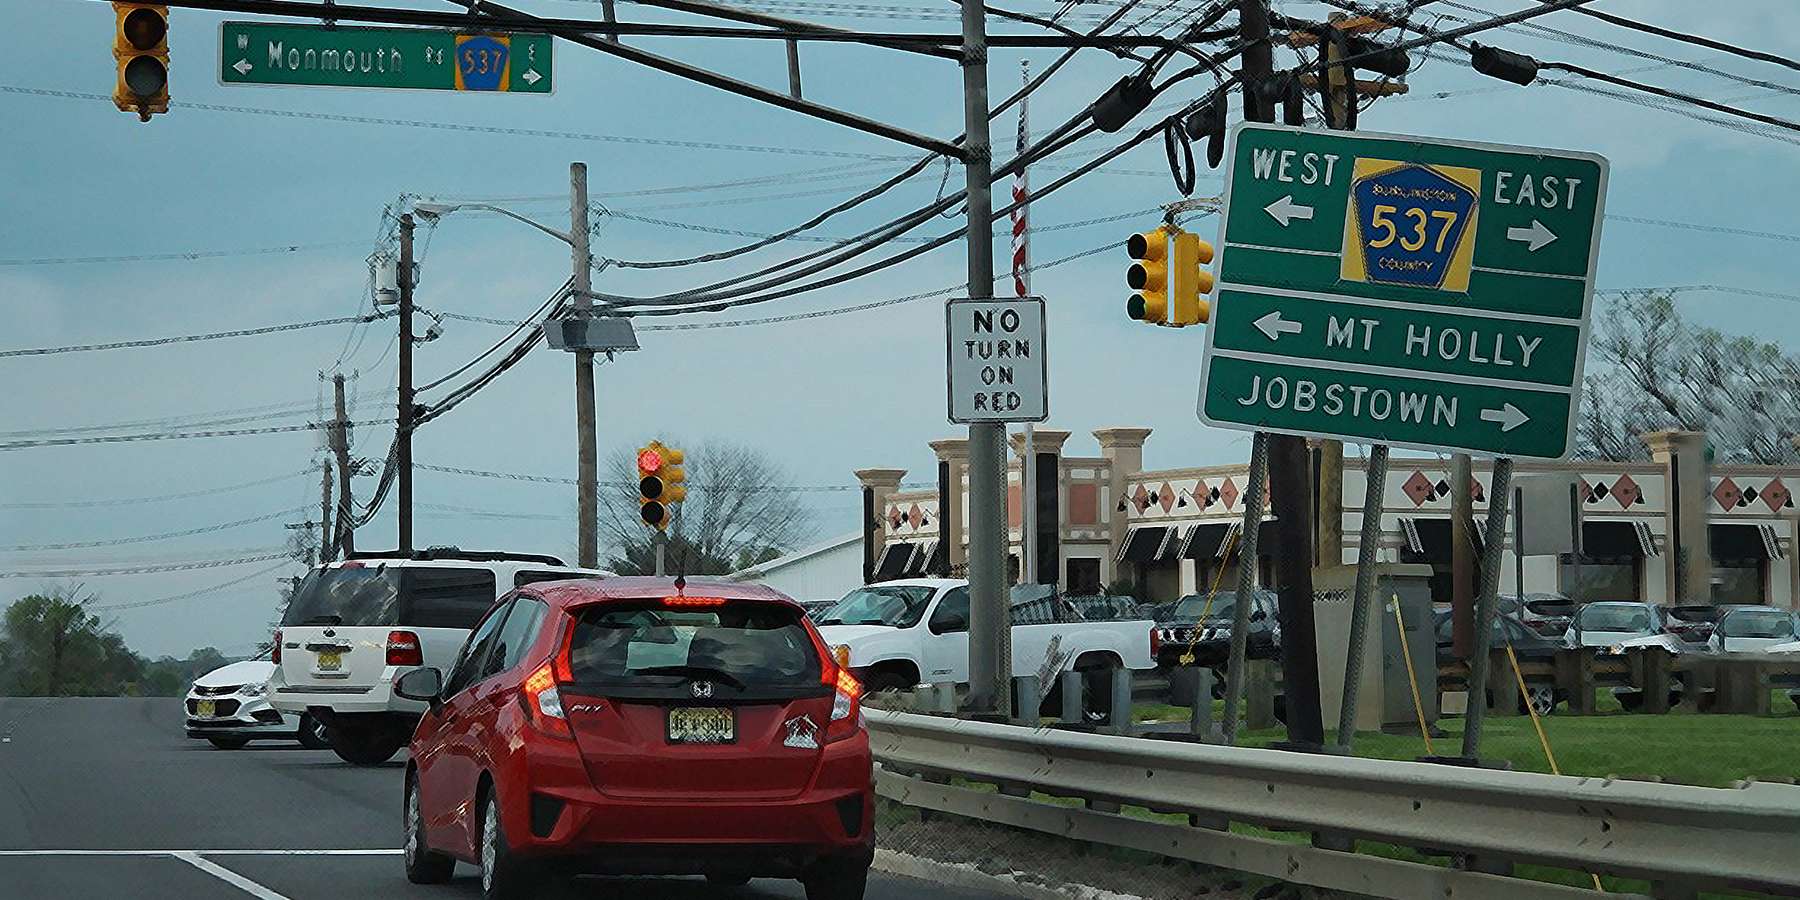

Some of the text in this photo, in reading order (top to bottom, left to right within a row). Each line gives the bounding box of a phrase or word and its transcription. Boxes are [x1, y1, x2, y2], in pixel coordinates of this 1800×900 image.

[268, 41, 402, 73] Monmouth
[464, 49, 502, 74] 537
[1253, 148, 1340, 186] WEST
[1494, 171, 1581, 210] EAST
[1369, 204, 1458, 253] 537
[1378, 257, 1433, 271] COUNTY
[973, 308, 1020, 333] NO
[964, 339, 1030, 360] TURN
[1326, 315, 1543, 368] MT HOLLY
[981, 365, 1014, 385] ON
[973, 391, 1021, 412] RED
[1237, 375, 1459, 428] JOBSTOWN
